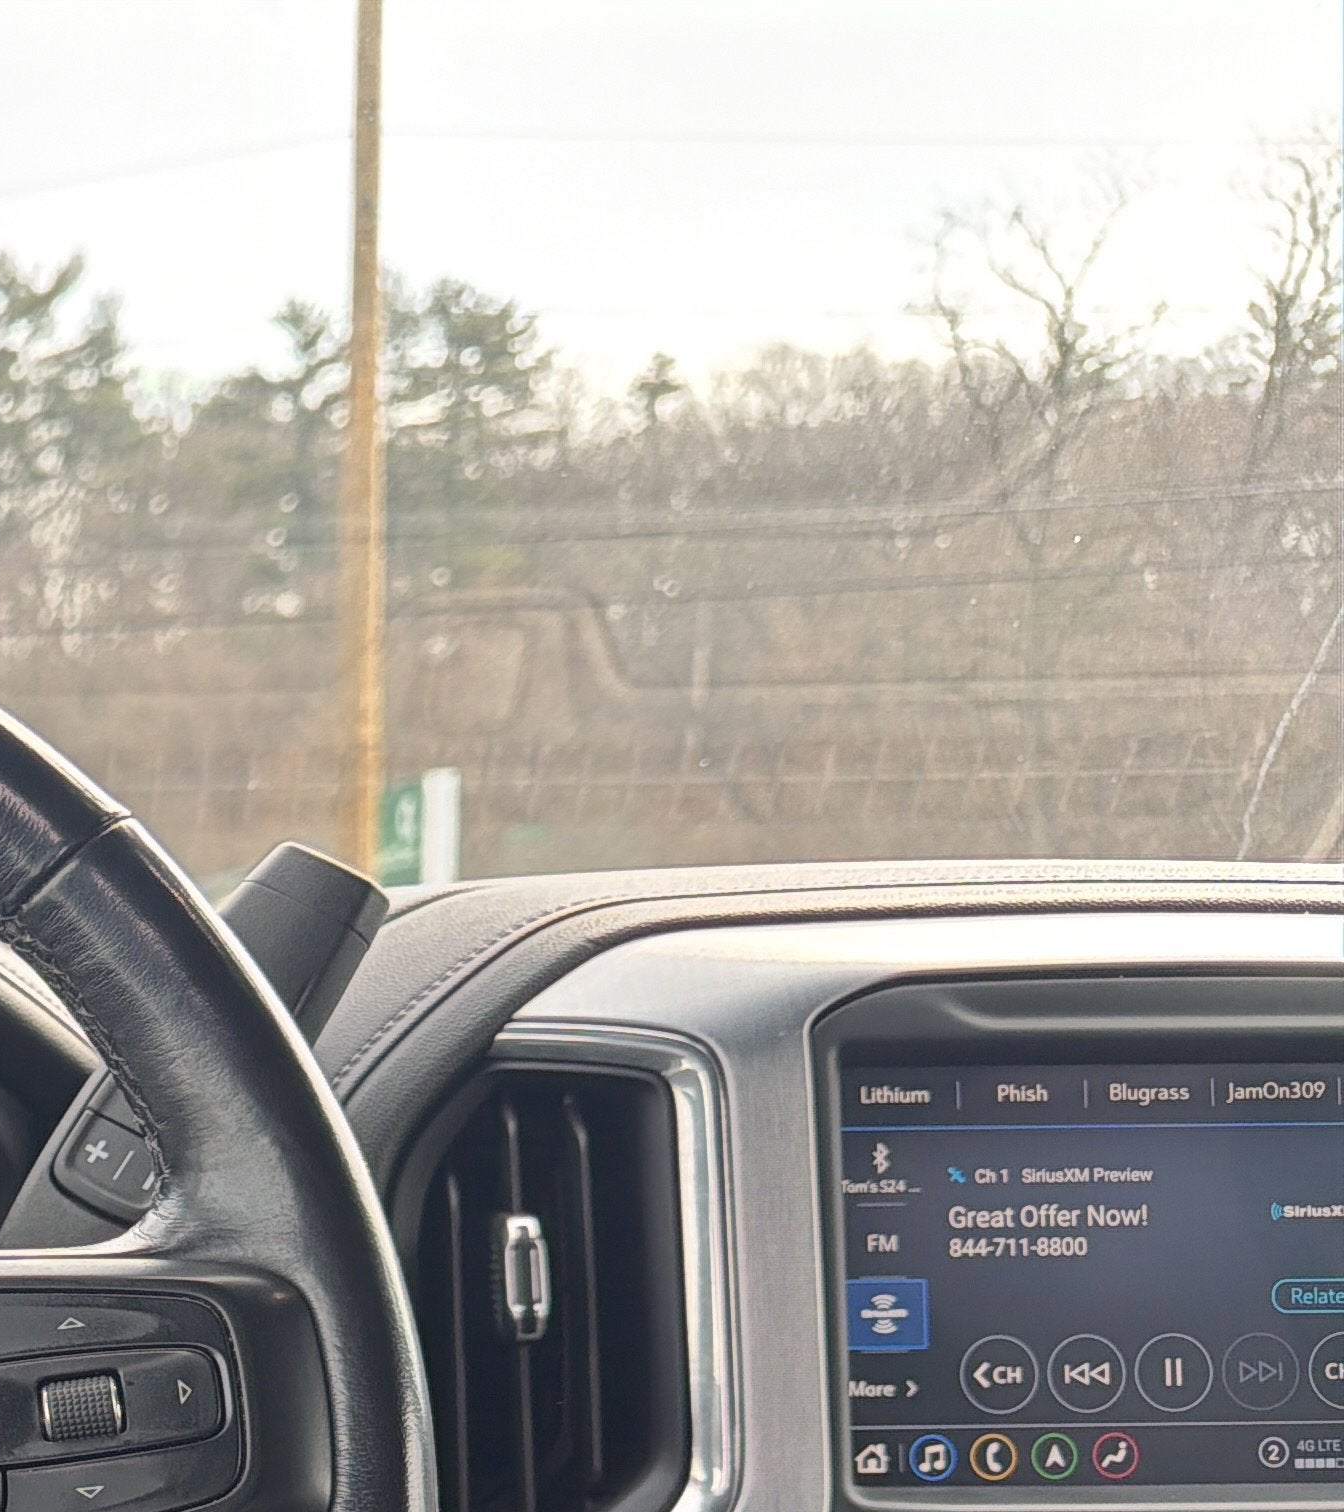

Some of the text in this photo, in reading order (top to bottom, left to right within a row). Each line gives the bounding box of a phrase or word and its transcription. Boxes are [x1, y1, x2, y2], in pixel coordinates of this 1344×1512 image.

[860, 1085, 931, 1104] Lithium
[997, 1084, 1048, 1102] Phish
[1109, 1082, 1190, 1106] Blugrass
[1226, 1081, 1326, 1103] JamOn309
[974, 1167, 1154, 1184] Ch 1 SiriusXM Preview
[948, 1204, 1149, 1228] Great Offer Now!
[867, 1234, 899, 1252] FM
[948, 1237, 1088, 1258] 844-711-8800
[848, 1380, 897, 1397] More
[1296, 1439, 1341, 1452] 4G LTE
